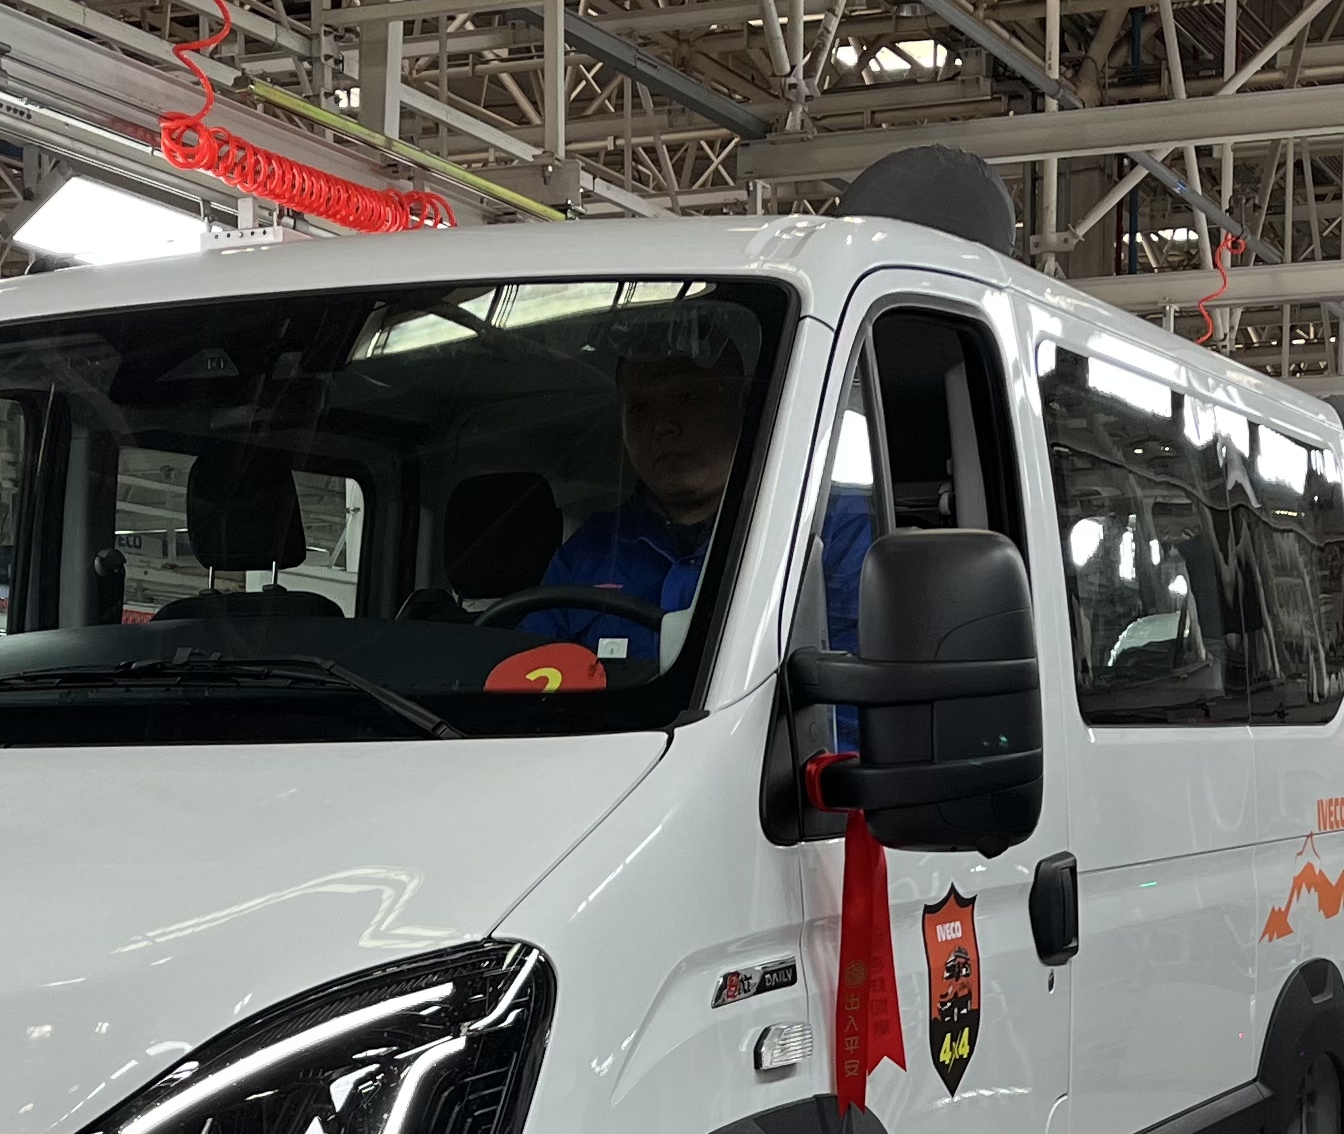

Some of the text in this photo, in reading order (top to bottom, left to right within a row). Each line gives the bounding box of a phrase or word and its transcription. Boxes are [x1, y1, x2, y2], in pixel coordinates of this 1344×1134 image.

[936, 921, 963, 942] IVECO
[764, 968, 793, 986] DAILY
[844, 993, 860, 1078] 出入平安
[939, 1027, 970, 1069] 4x4
